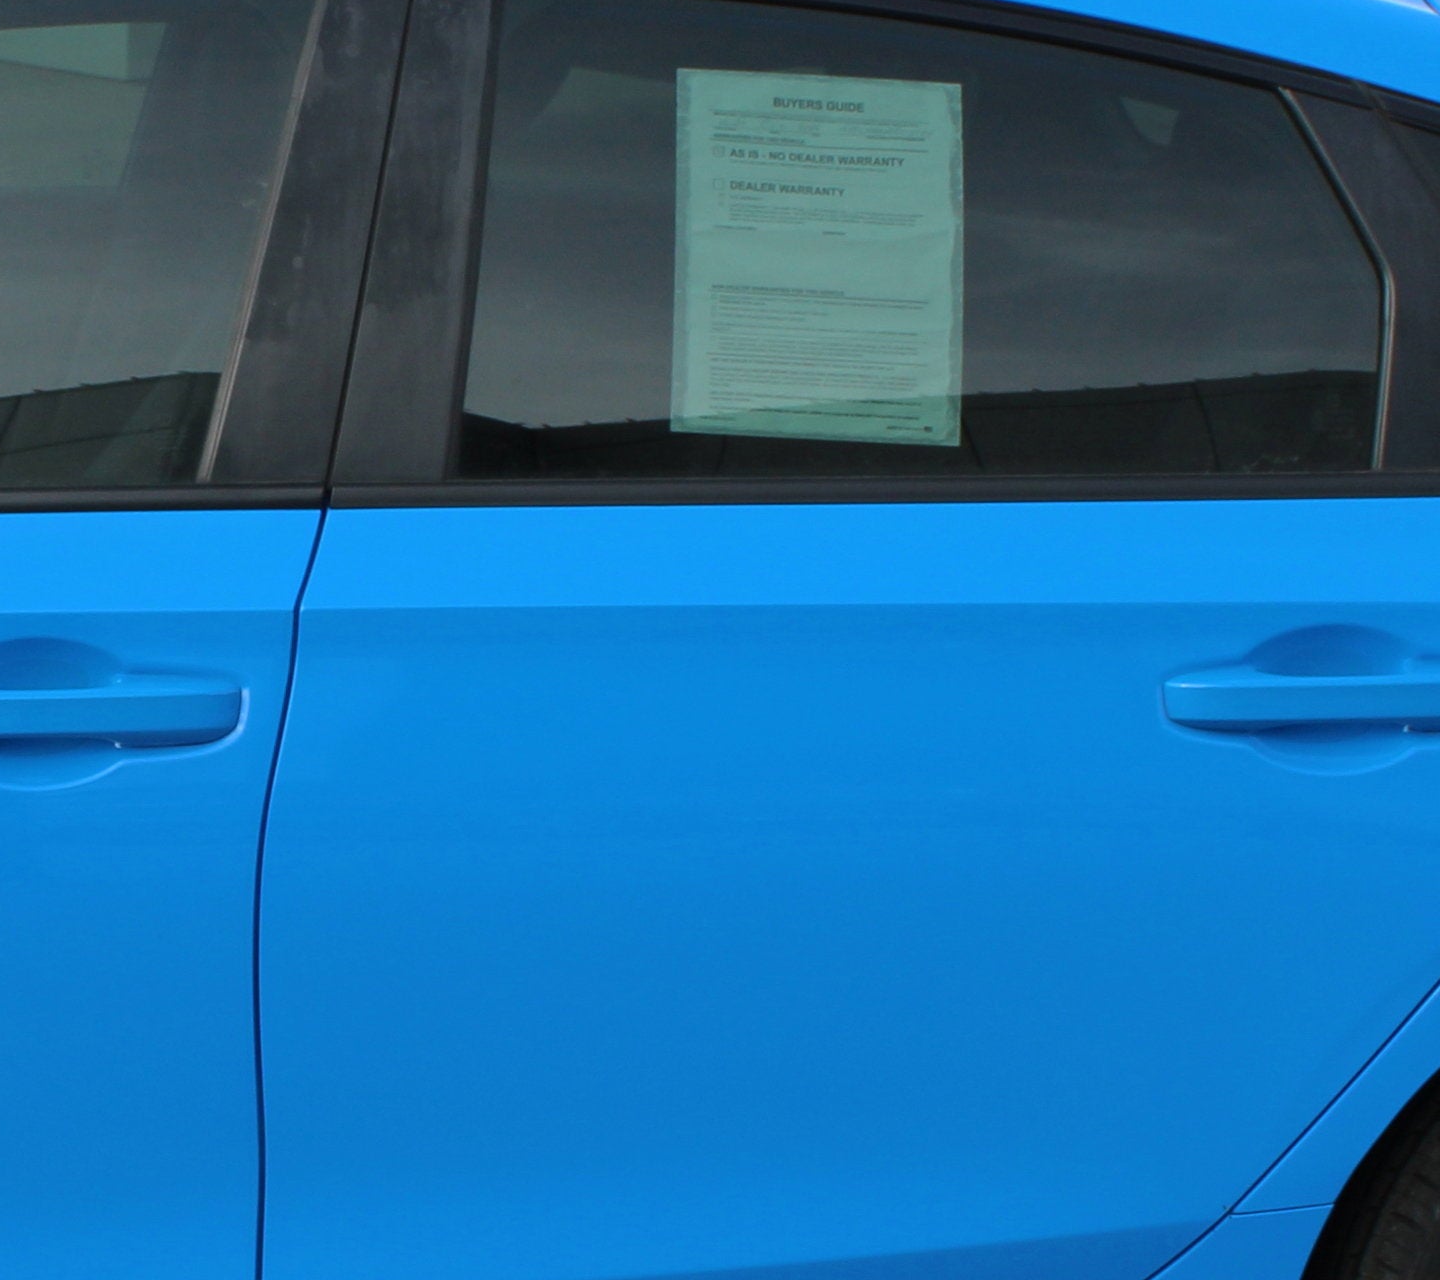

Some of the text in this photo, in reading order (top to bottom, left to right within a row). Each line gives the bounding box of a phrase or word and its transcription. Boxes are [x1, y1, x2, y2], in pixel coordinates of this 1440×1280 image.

[772, 97, 865, 113] BUYERS GUIDE
[729, 148, 745, 158] AS
[748, 149, 760, 159] IS
[769, 151, 786, 161] NO
[789, 152, 835, 165] DEALER
[837, 155, 905, 168] WARRANTY
[729, 180, 846, 198] DEALER WARRANTY
